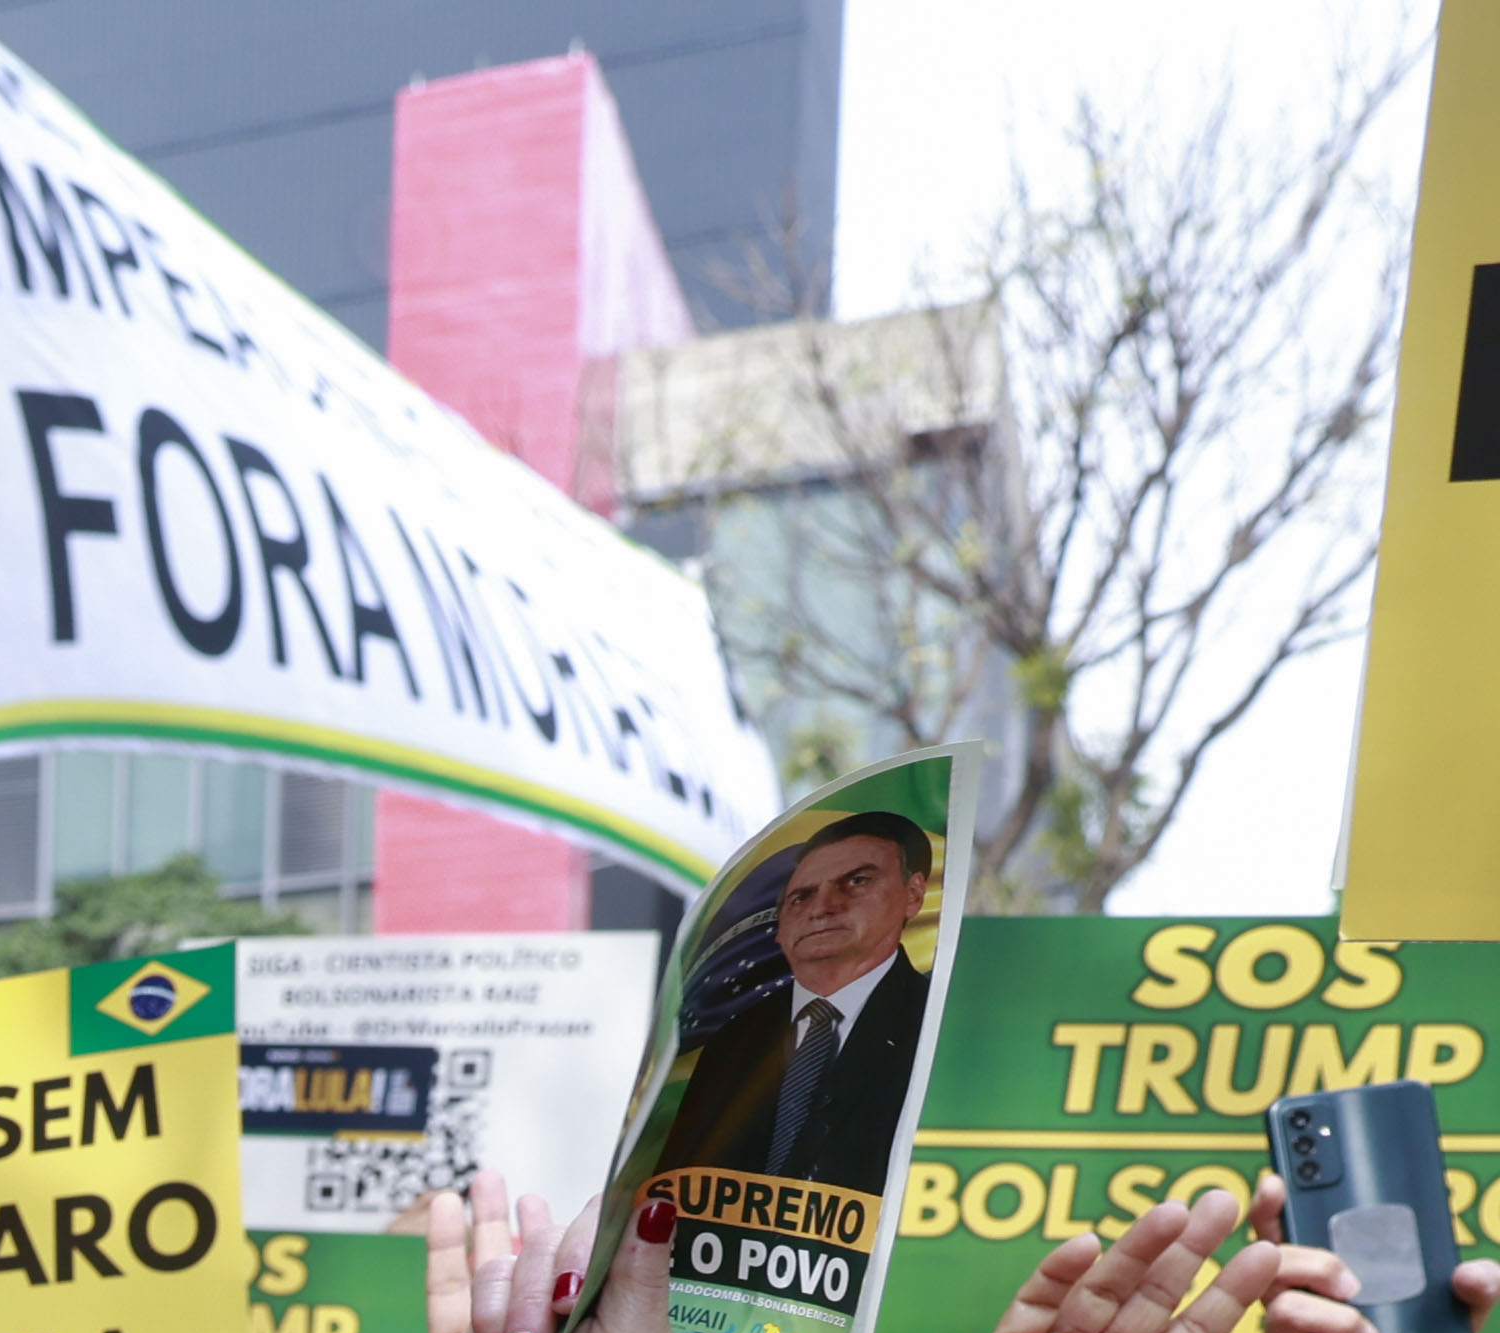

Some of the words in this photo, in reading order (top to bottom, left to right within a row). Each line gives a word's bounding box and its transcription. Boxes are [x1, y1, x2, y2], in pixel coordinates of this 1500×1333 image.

[12, 387, 420, 700] FORA
[1132, 926, 1404, 1010] SOS
[1052, 1023, 1484, 1115] TRUMP
[691, 1232, 723, 1275] O
[738, 1238, 850, 1302] POVO
[668, 1304, 728, 1330] AWAII
